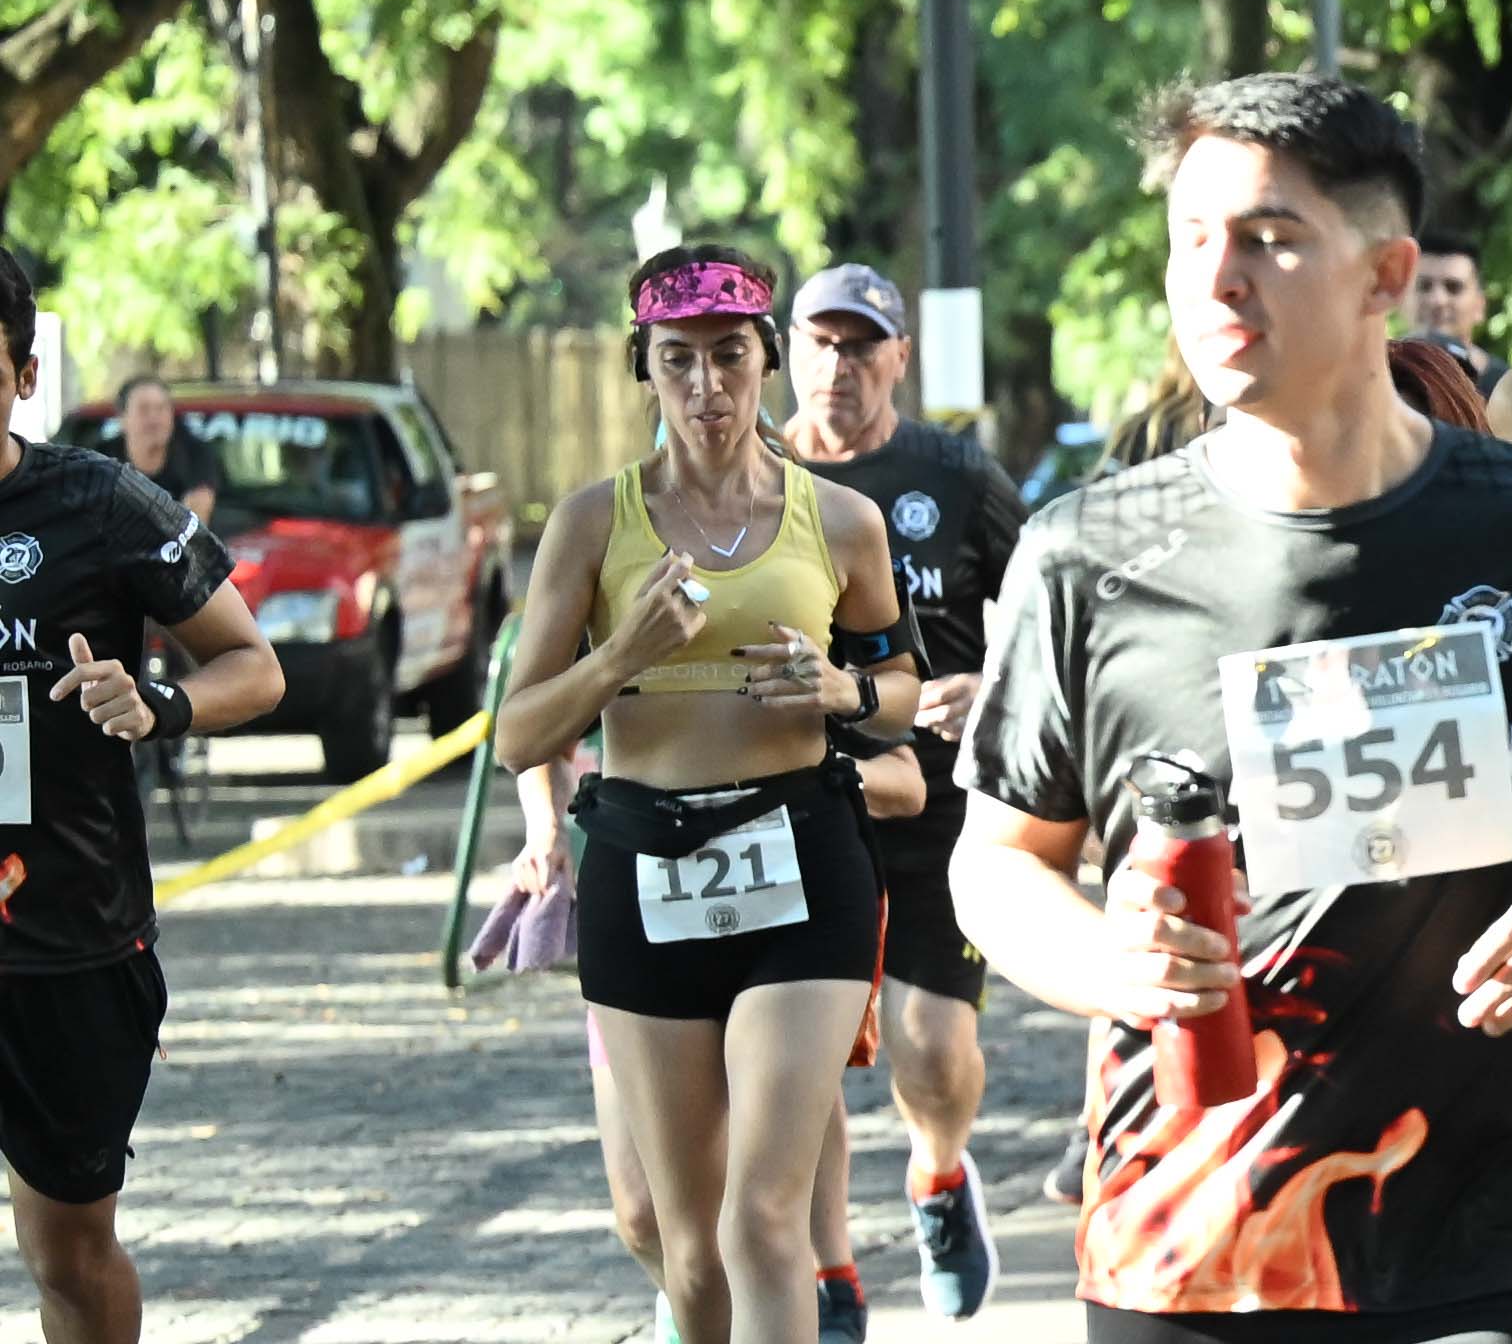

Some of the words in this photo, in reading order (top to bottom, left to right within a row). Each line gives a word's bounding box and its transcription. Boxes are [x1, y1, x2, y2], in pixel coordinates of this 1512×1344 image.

[3, 660, 53, 671] ROSARIO
[1273, 719, 1475, 822] 554
[657, 842, 777, 902] 121
